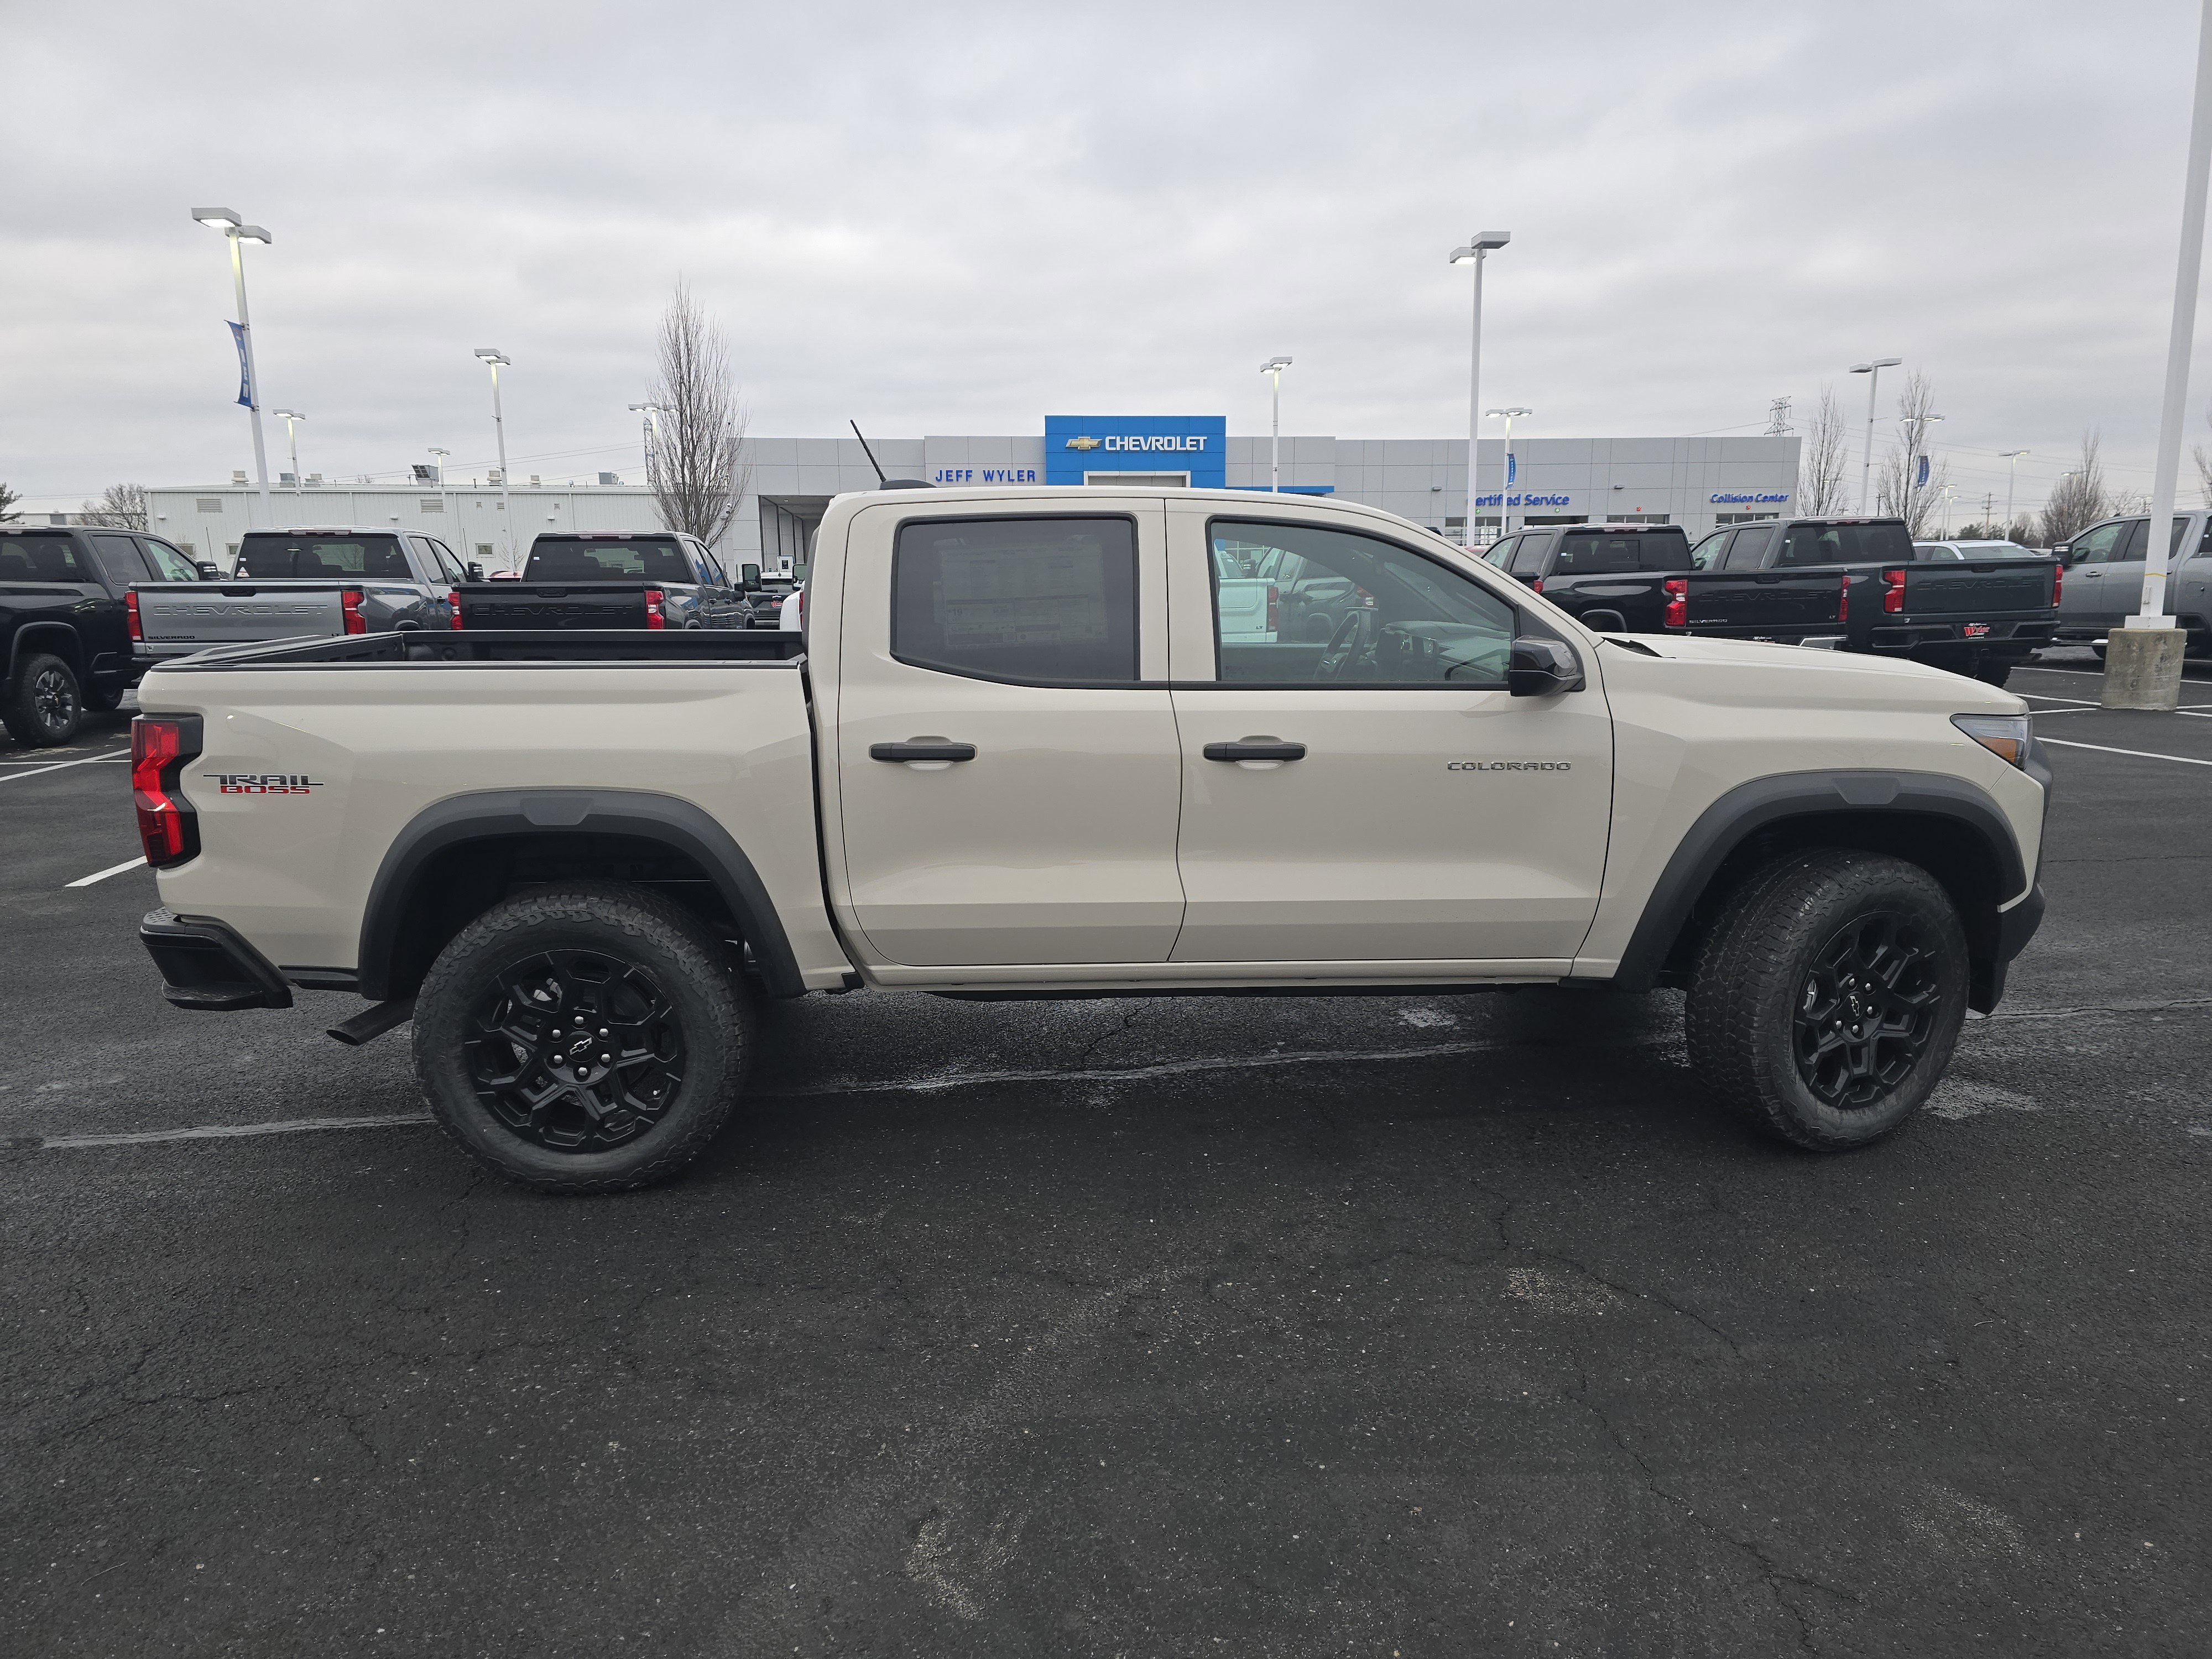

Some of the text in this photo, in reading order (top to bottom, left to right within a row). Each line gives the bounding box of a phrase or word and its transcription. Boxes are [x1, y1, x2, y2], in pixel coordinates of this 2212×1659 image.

[1105, 436, 1208, 451] CHEVROLET
[935, 469, 1036, 482] JEFF WYLER
[1467, 493, 1570, 507] ertifed Service
[1710, 493, 1790, 503] Collision Center
[153, 605, 328, 616] CHEVROLET
[1448, 761, 1572, 770] COLORADO
[202, 774, 325, 785] TRAIL
[220, 785, 310, 794] BOSS
